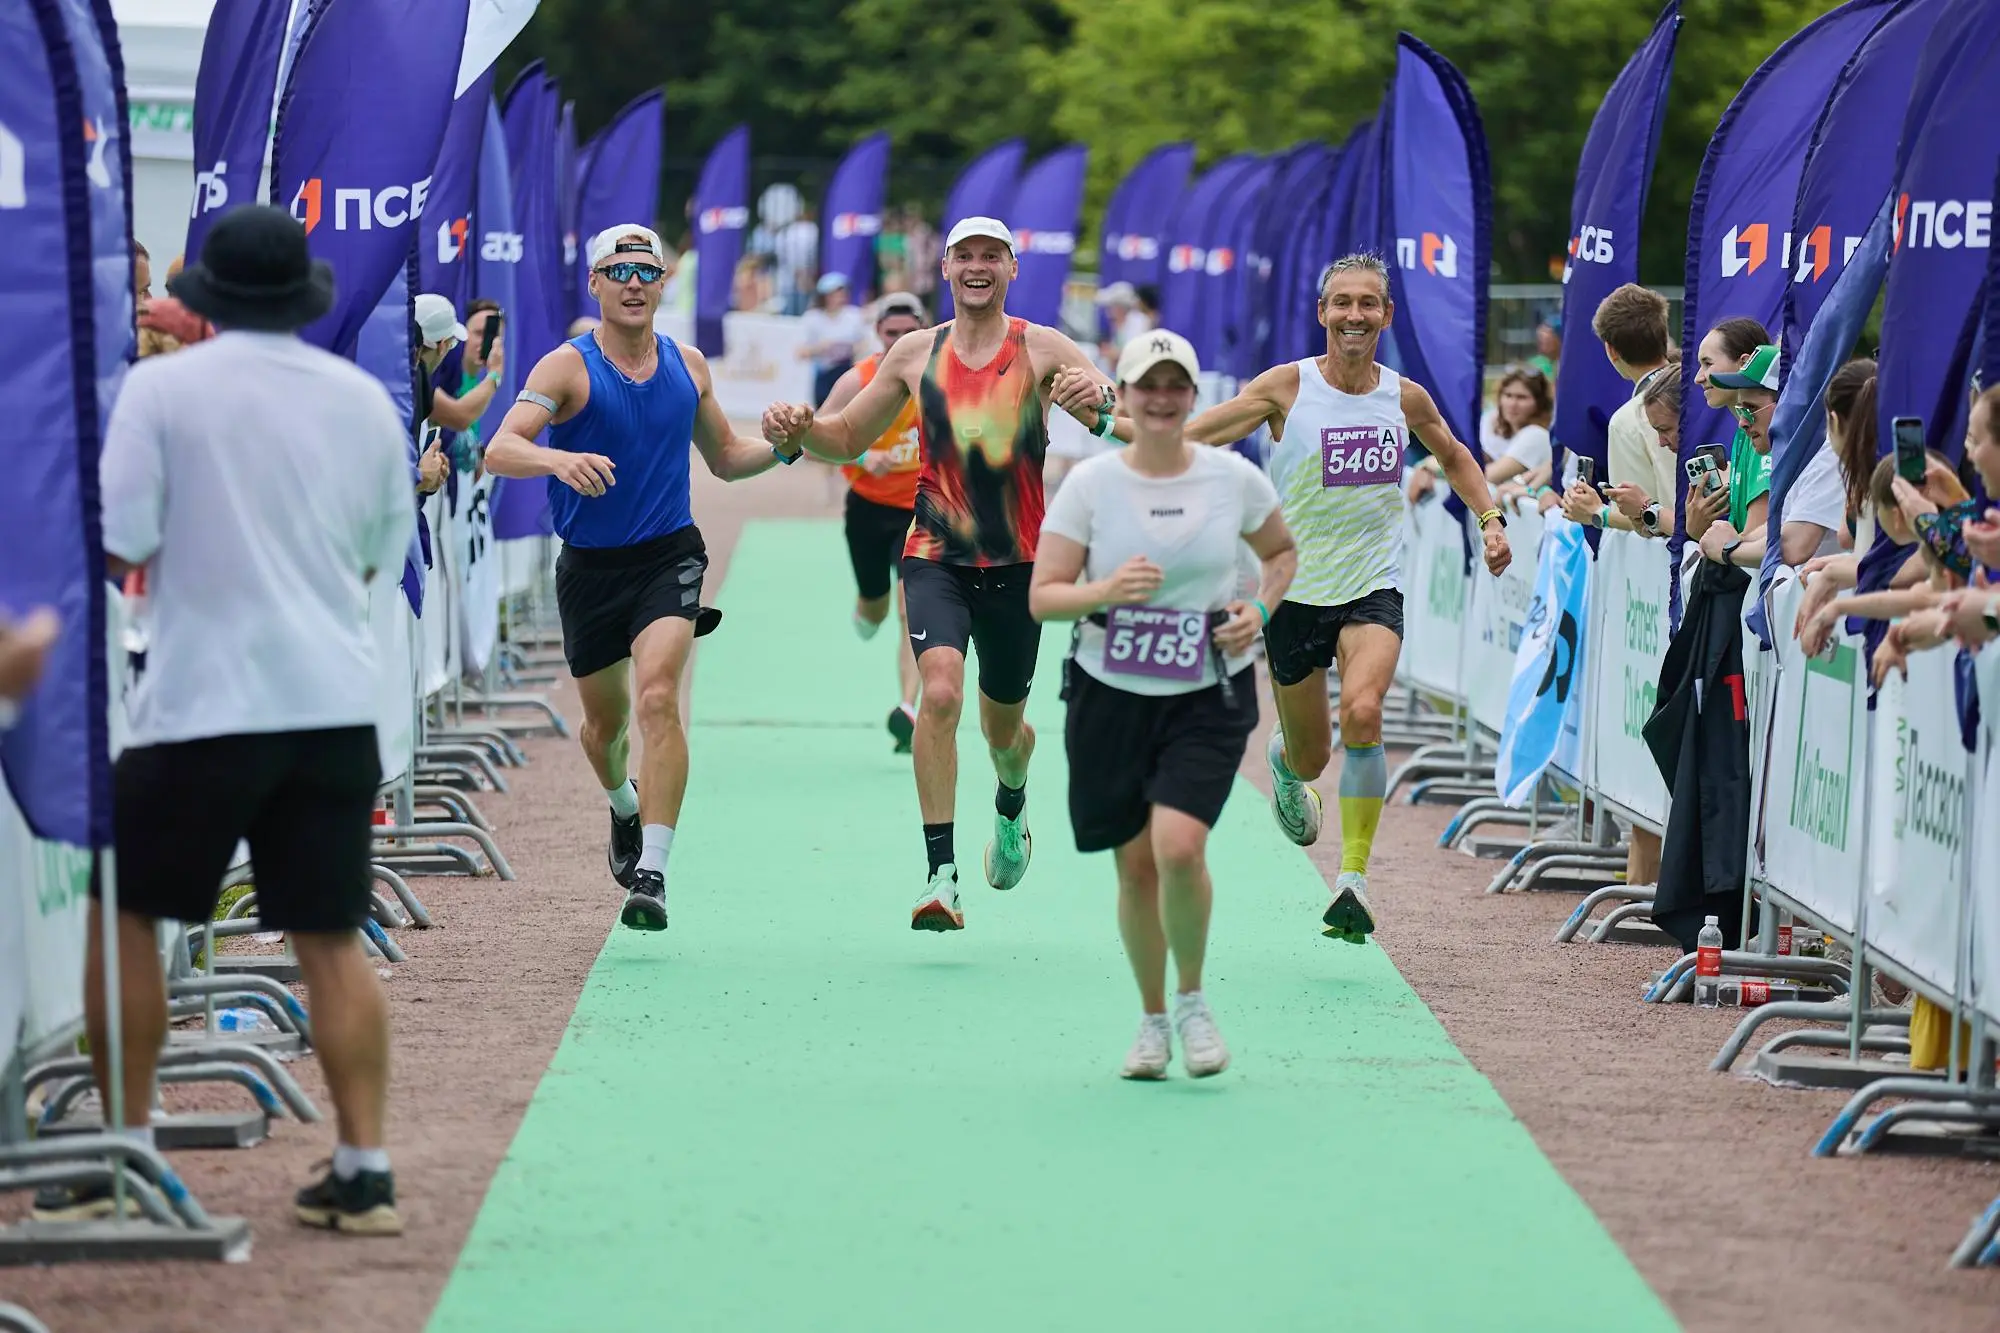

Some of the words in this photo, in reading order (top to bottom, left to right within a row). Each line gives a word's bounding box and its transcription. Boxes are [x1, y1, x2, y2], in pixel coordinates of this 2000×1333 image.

[1382, 429, 1396, 445] A
[1328, 446, 1398, 475] 5469
[1183, 616, 1200, 636] C
[1110, 629, 1198, 668] 5155
